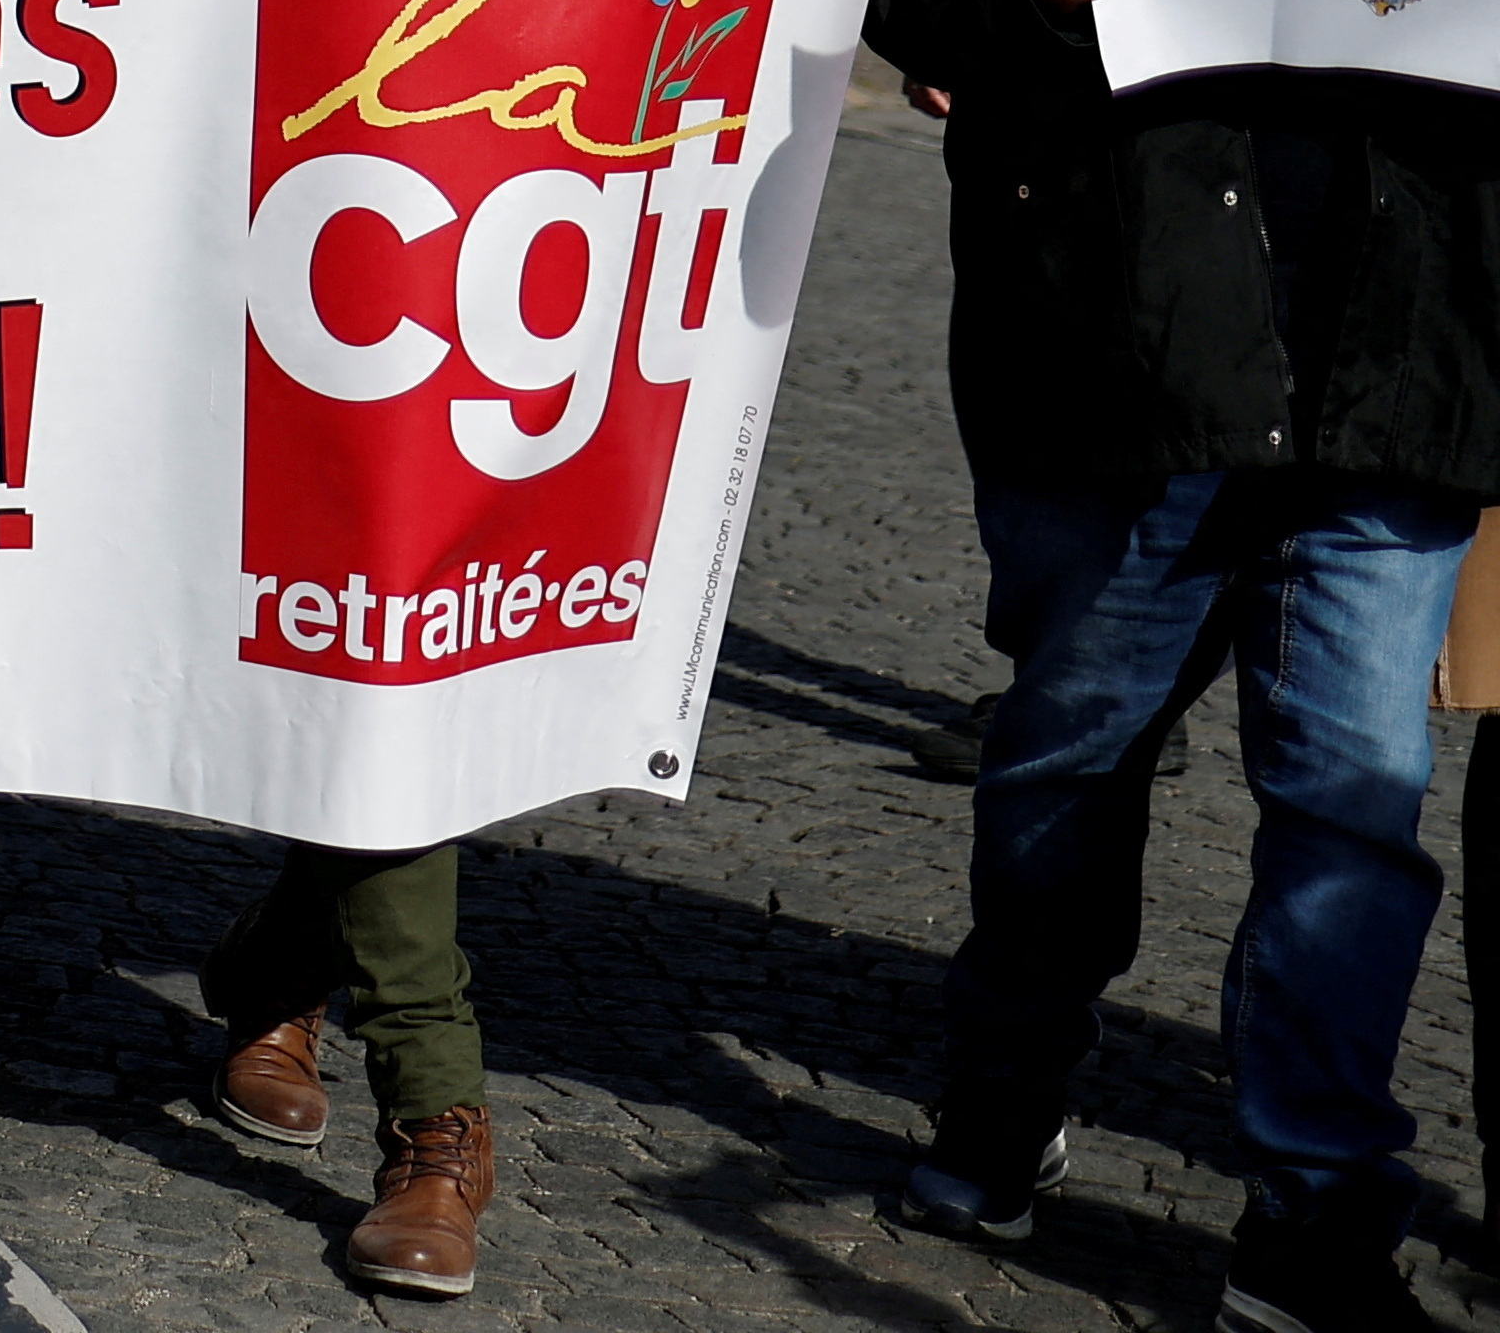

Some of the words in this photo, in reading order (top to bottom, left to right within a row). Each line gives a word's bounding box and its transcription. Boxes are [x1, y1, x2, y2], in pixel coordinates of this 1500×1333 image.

[246, 98, 745, 481] cgt
[742, 405, 758, 424] 70
[738, 426, 752, 445] 07
[733, 447, 748, 463] 18
[728, 467, 744, 486] 32
[724, 487, 740, 506] 02
[676, 519, 732, 721] www.LMcommunication.com
